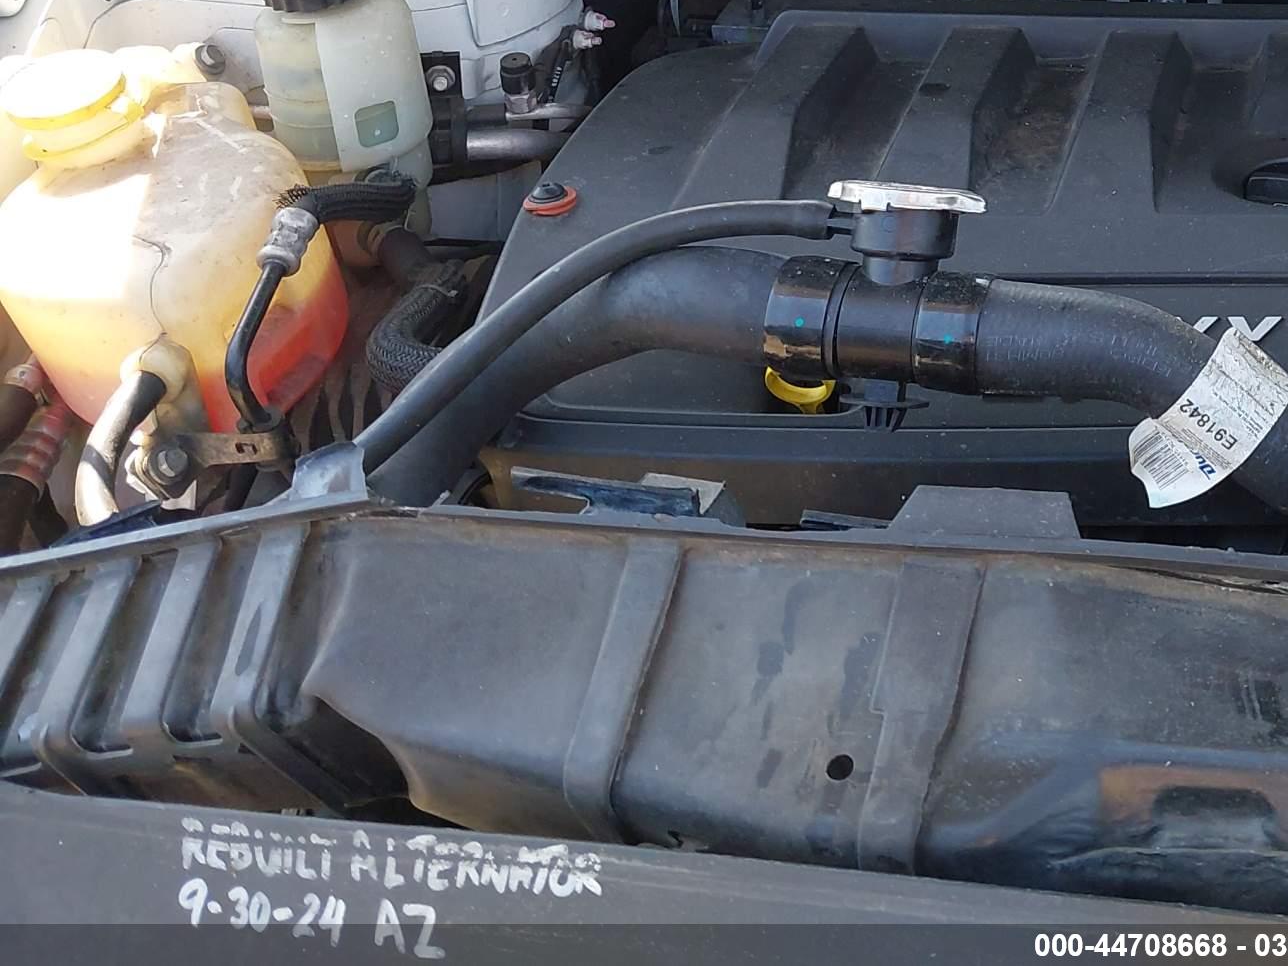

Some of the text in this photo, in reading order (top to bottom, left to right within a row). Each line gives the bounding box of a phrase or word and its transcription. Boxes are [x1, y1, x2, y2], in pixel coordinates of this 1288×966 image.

[1179, 398, 1238, 451] E91842
[351, 829, 602, 898] ALTERNATOR
[178, 876, 347, 949] 9-30-24
